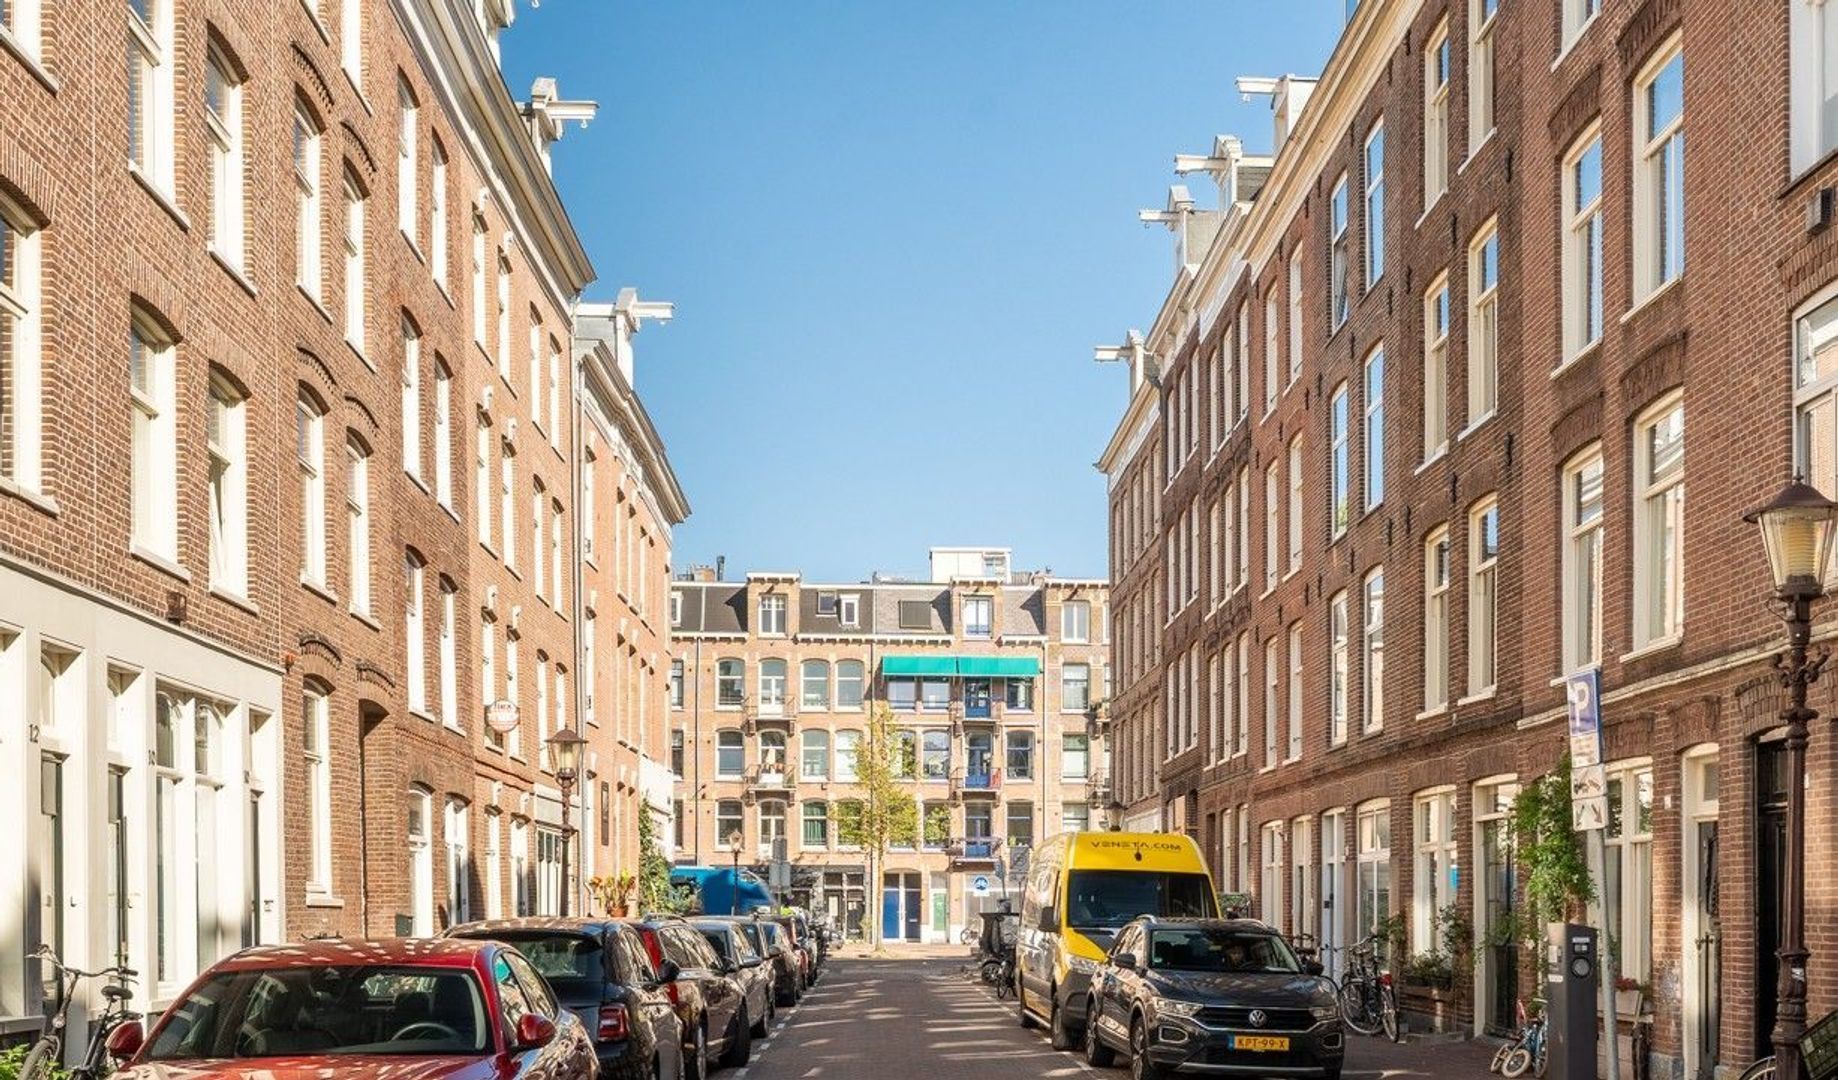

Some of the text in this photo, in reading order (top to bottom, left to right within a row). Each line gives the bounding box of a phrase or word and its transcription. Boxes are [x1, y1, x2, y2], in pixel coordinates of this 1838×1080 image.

[1572, 681, 1590, 728] P
[28, 723, 40, 744] 12
[1091, 841, 1182, 852] VENETA.COM
[1236, 1036, 1286, 1049] KPT-99-X
